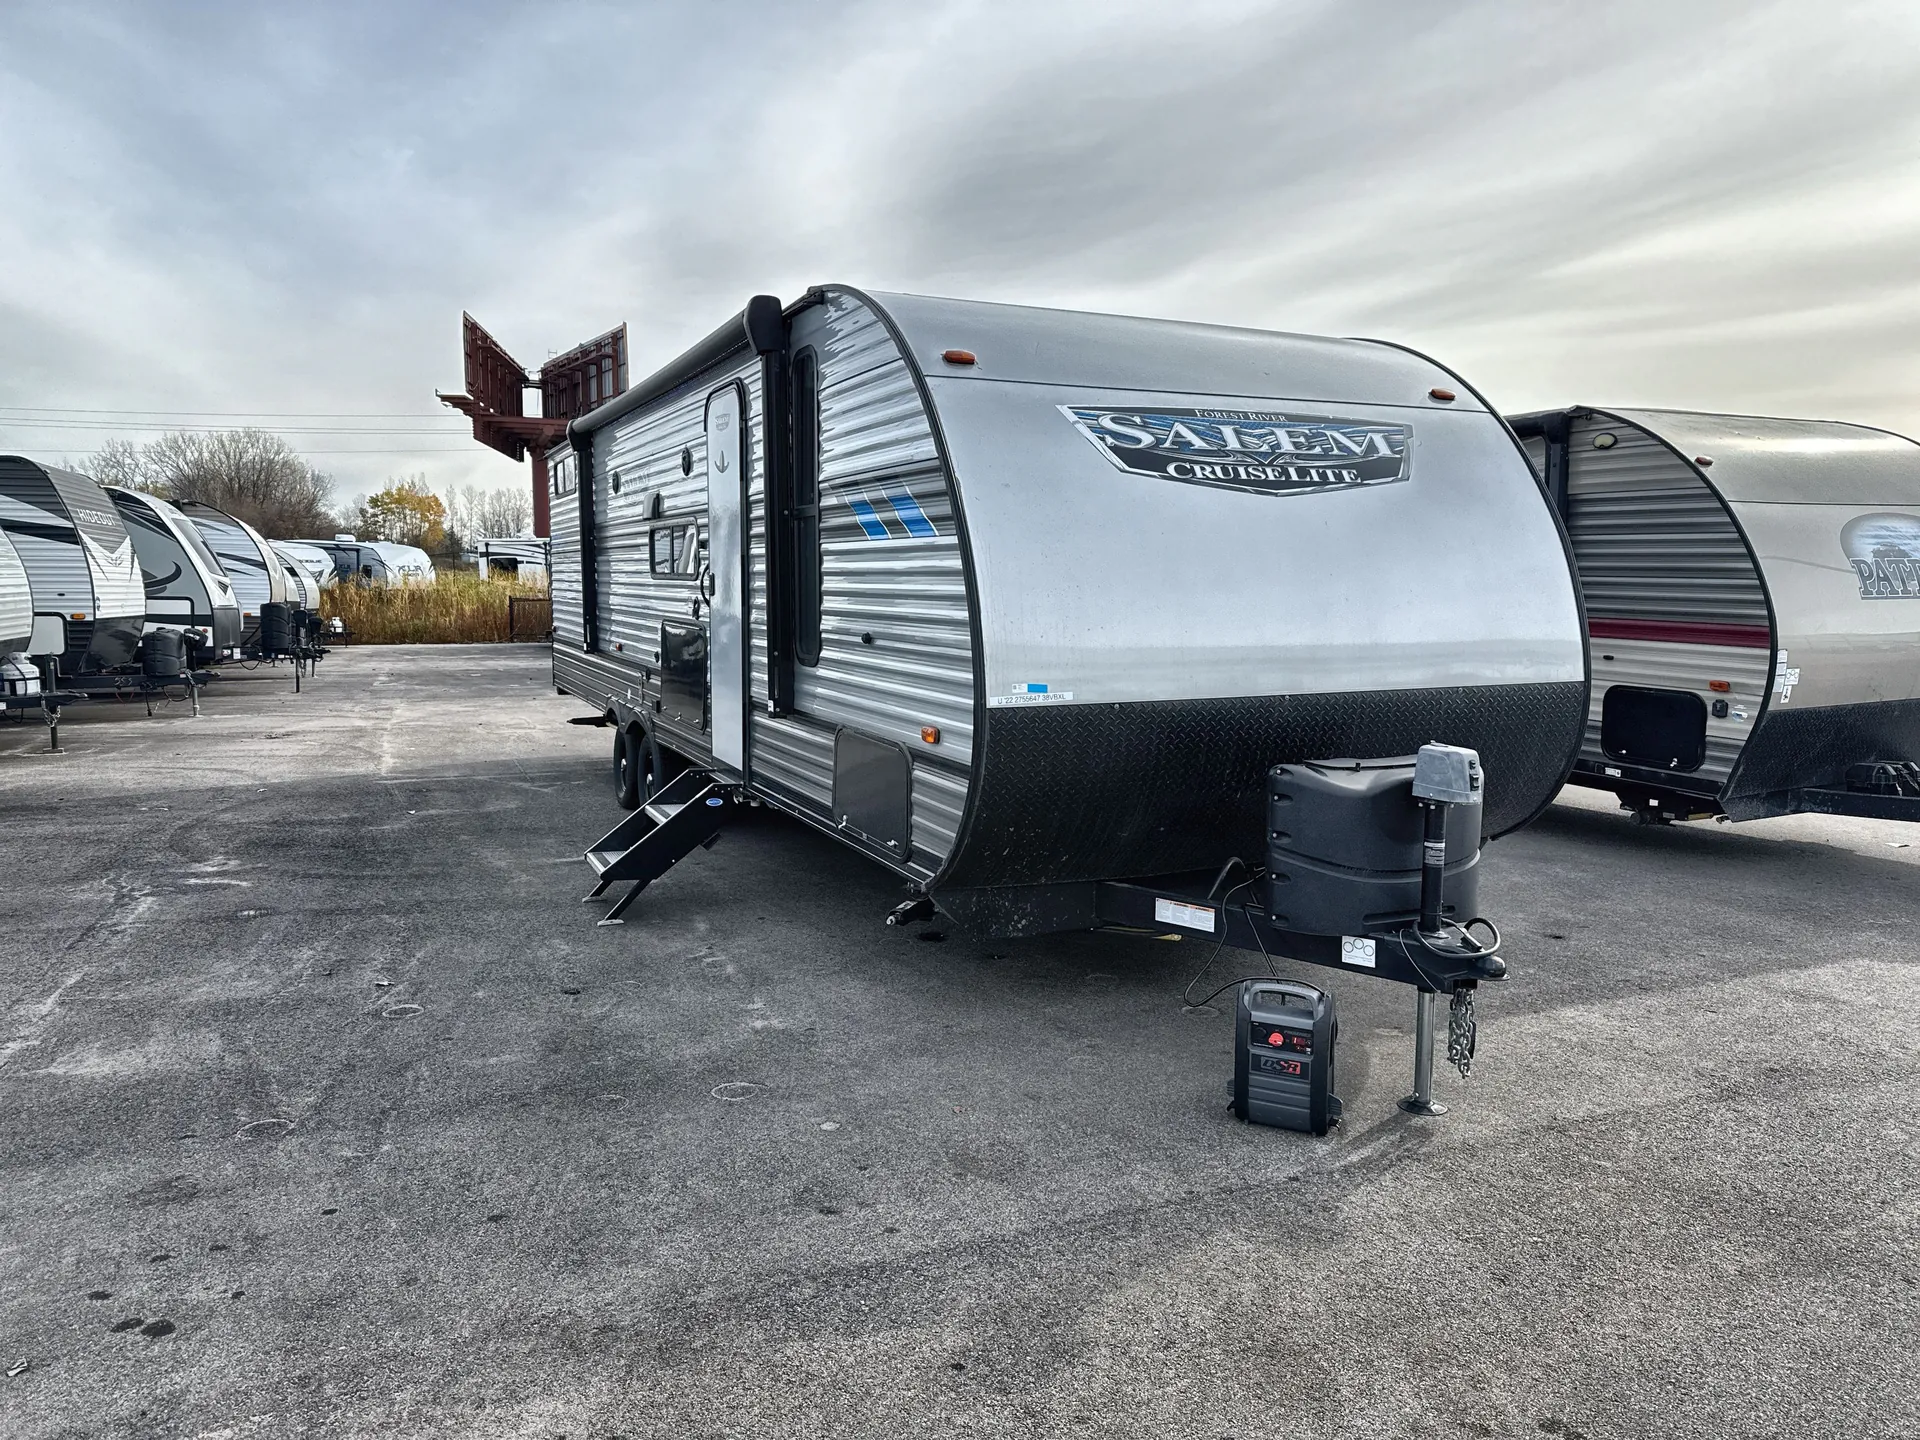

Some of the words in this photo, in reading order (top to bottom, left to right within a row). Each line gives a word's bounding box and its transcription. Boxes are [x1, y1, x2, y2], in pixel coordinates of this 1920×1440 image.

[1194, 409, 1245, 420] FOREST
[1247, 412, 1288, 422] RIVER
[1096, 413, 1403, 458] SALEM
[76, 508, 116, 526] HIDEOUT
[1850, 557, 1920, 598] PAT
[997, 697, 1003, 705] U
[1014, 694, 1040, 704] 2755647
[1041, 692, 1066, 702] 38VBXL
[1261, 1057, 1301, 1074] DSR
